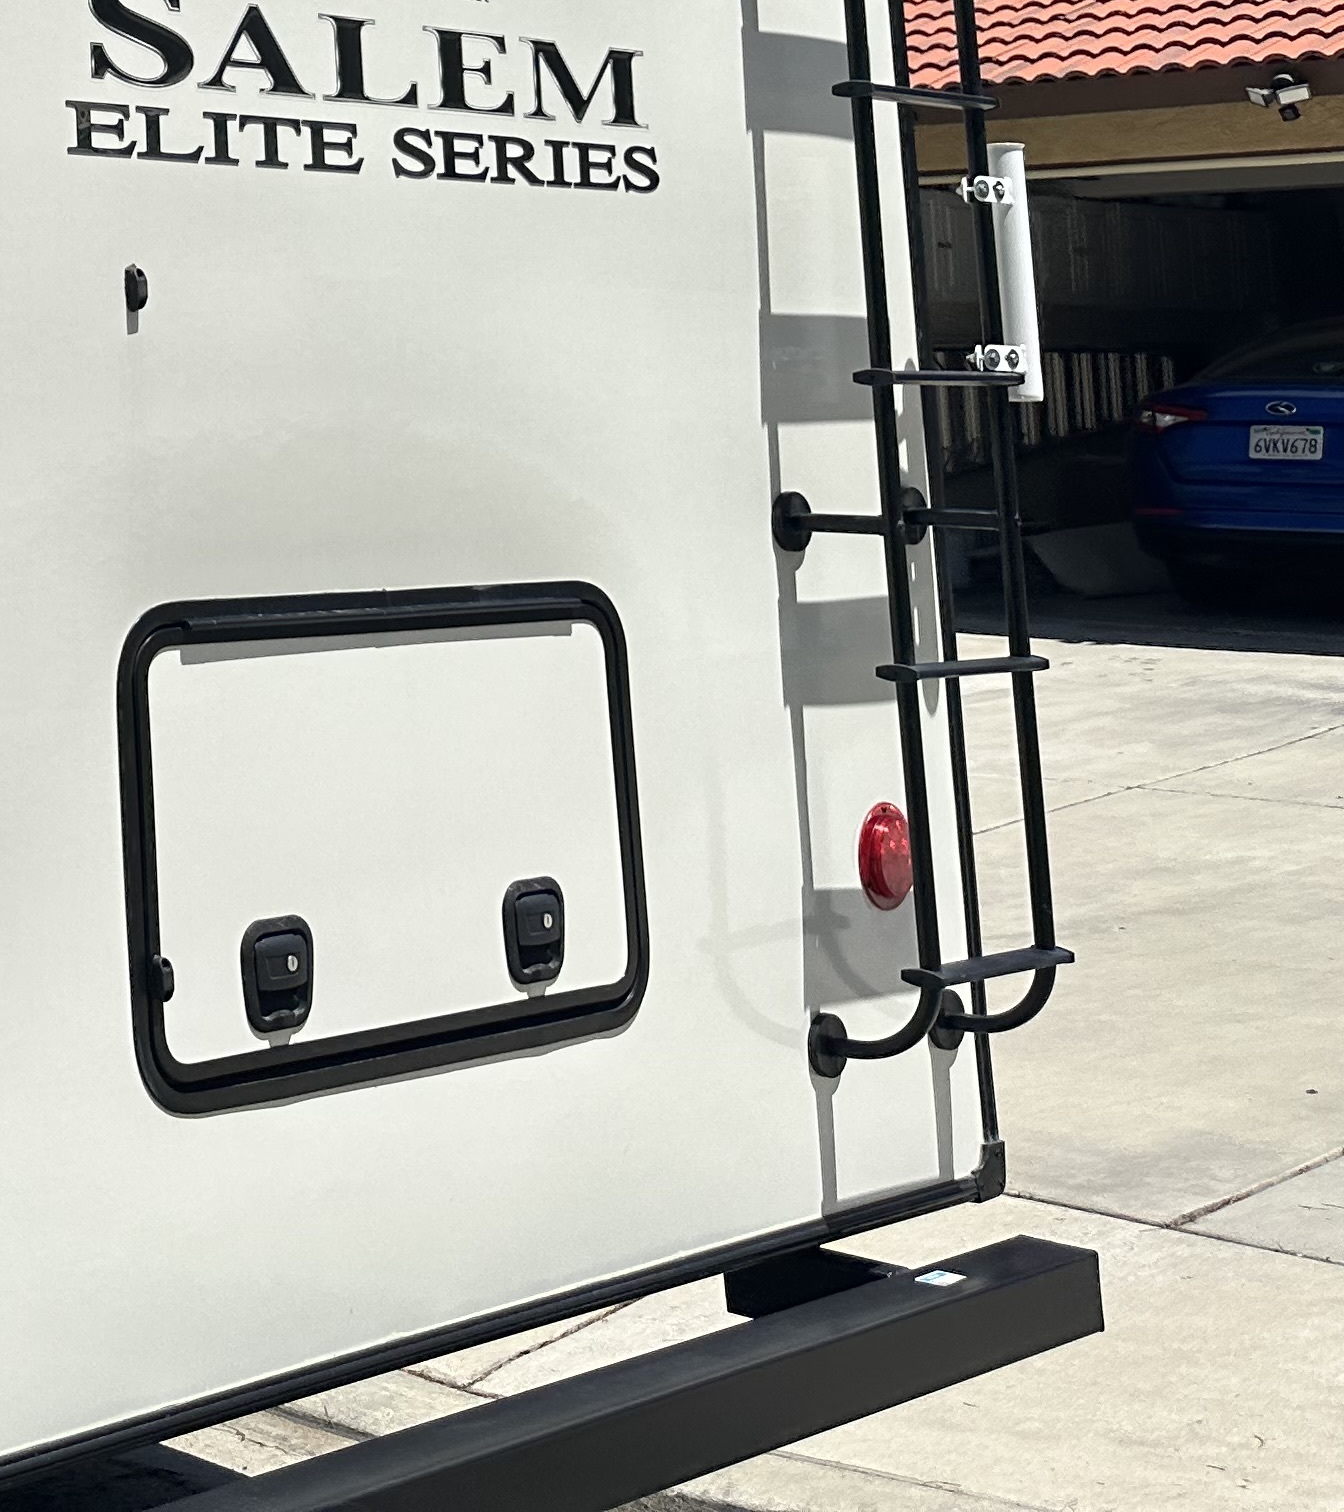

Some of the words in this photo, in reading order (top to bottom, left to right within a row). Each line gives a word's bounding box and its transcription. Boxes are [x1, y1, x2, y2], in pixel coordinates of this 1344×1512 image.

[65, 100, 365, 175] ELITE
[392, 127, 661, 194] SERIES
[1254, 438, 1318, 454] 6VKV678
